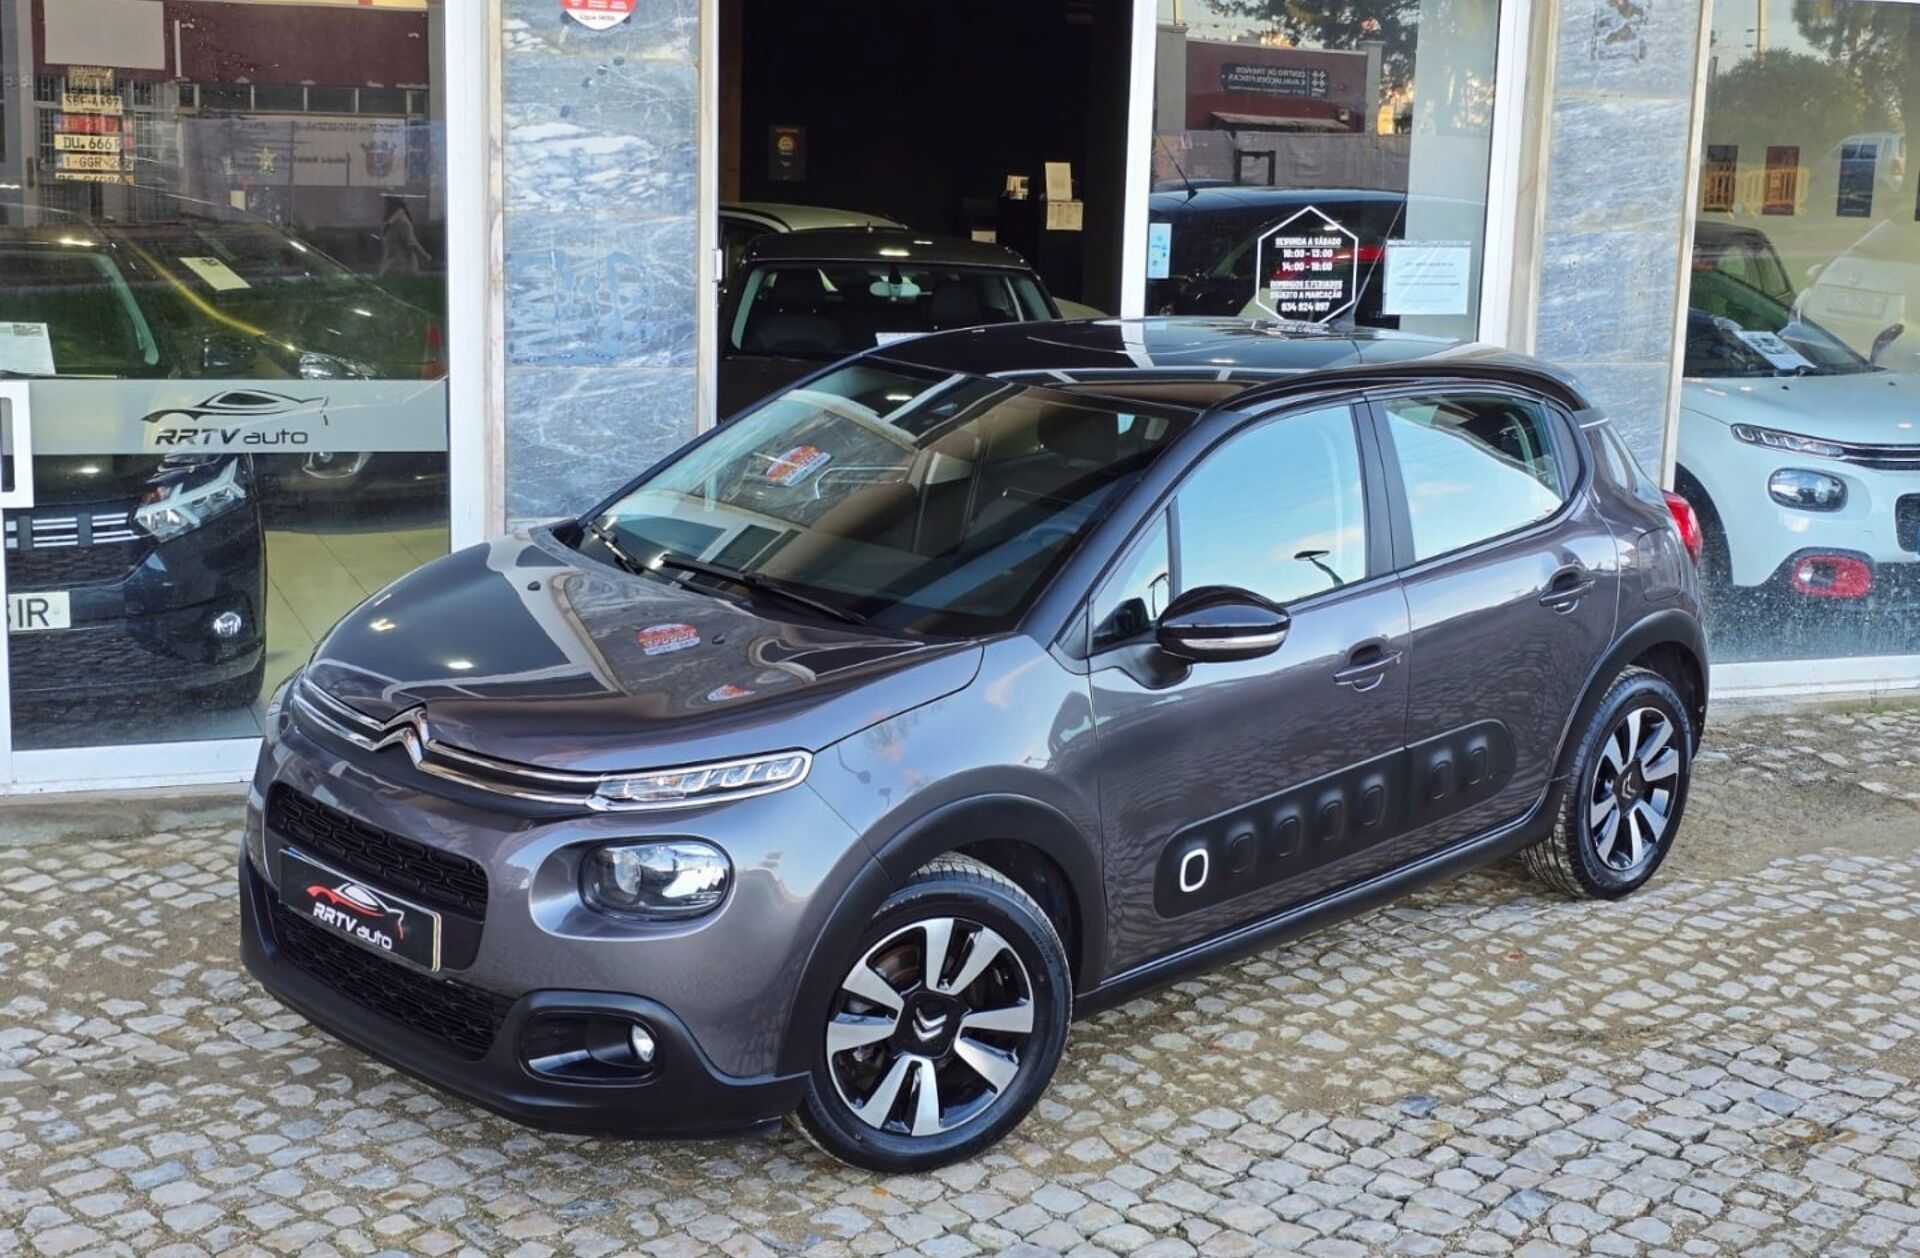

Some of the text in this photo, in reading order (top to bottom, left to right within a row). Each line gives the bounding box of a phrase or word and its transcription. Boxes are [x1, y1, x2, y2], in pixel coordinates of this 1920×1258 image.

[155, 428, 308, 446] RRTV auto
[312, 901, 393, 950] RRTV auto
